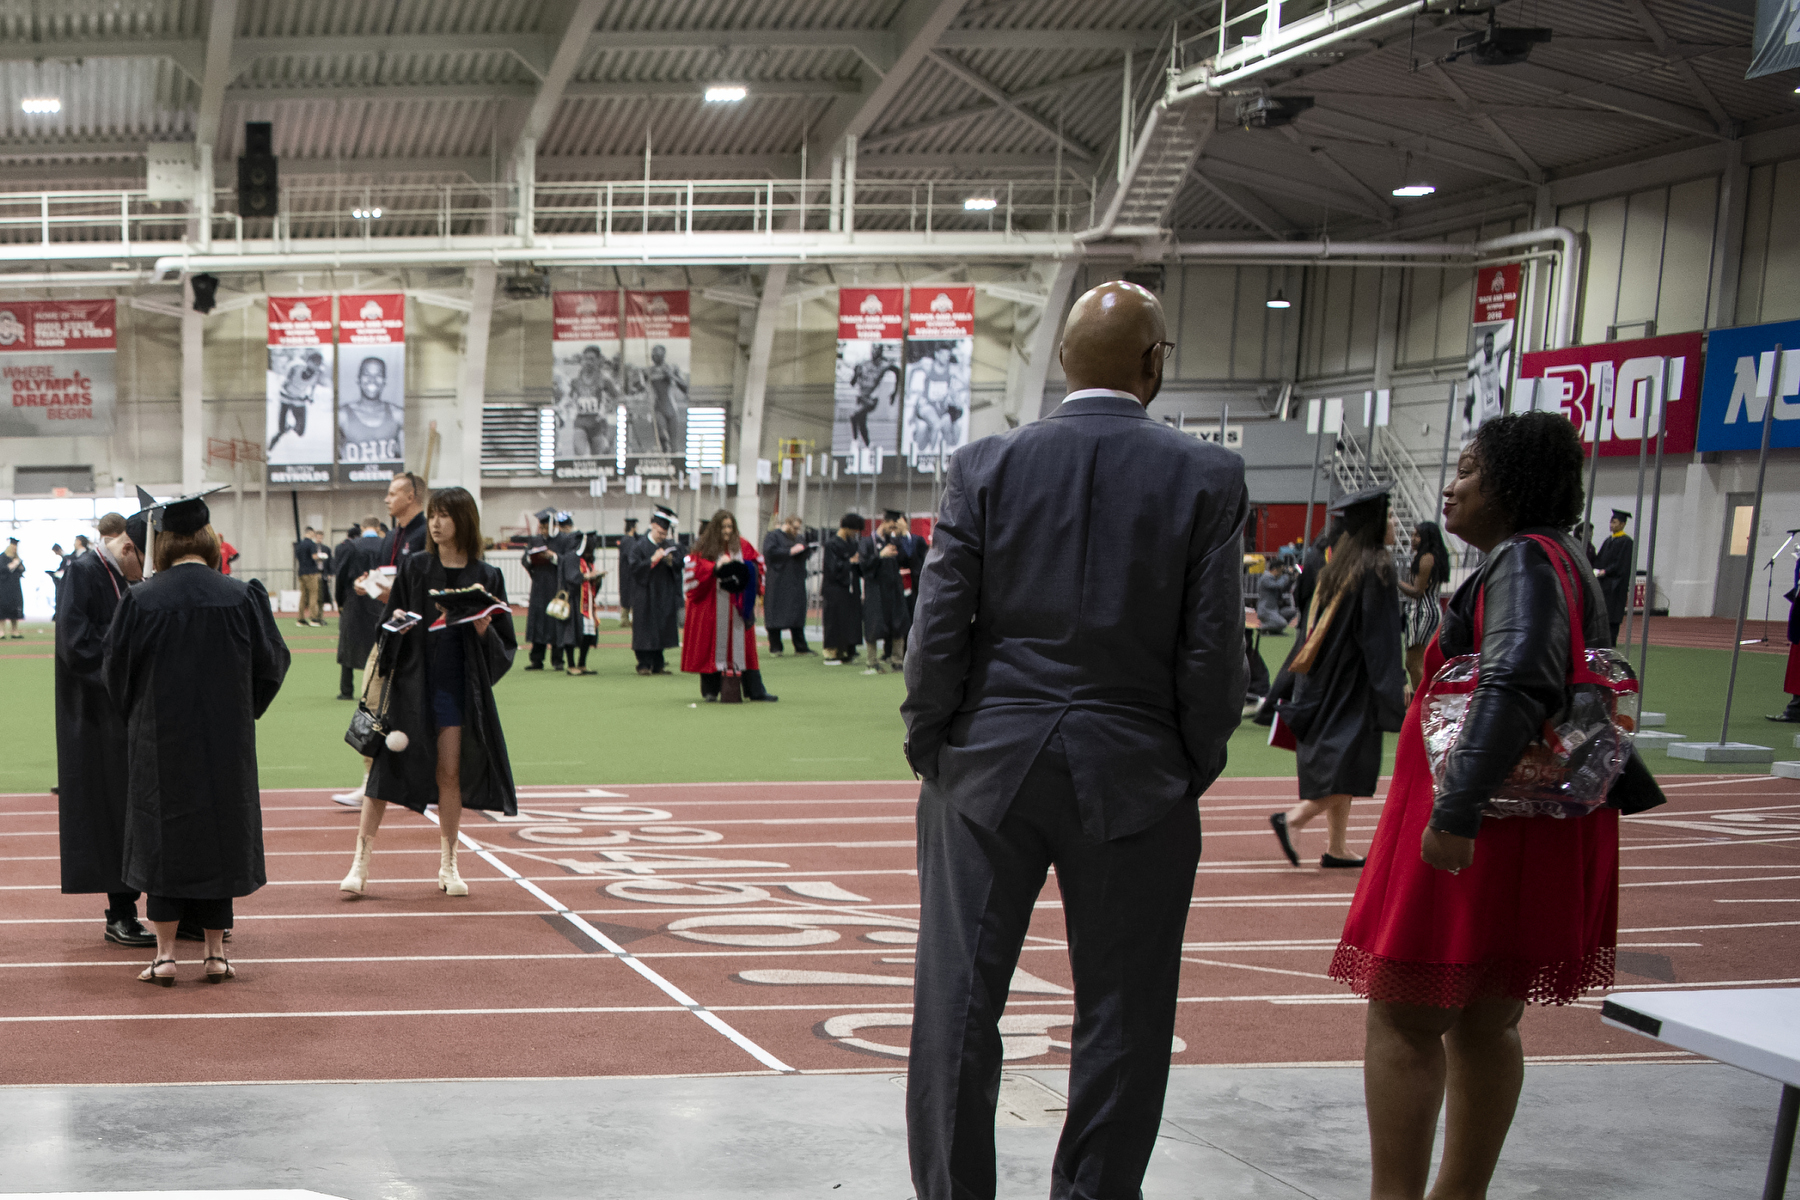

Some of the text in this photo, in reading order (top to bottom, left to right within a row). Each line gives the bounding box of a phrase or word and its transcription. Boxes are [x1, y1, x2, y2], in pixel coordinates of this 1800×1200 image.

[2, 365, 54, 378] WHERE
[12, 371, 91, 392] OLYMPIC
[12, 393, 92, 407] DREAMS
[46, 408, 92, 420] BEGIN
[270, 472, 330, 482] REYNOLDS
[349, 470, 394, 481] GREENE
[556, 467, 615, 478] CROGHAN
